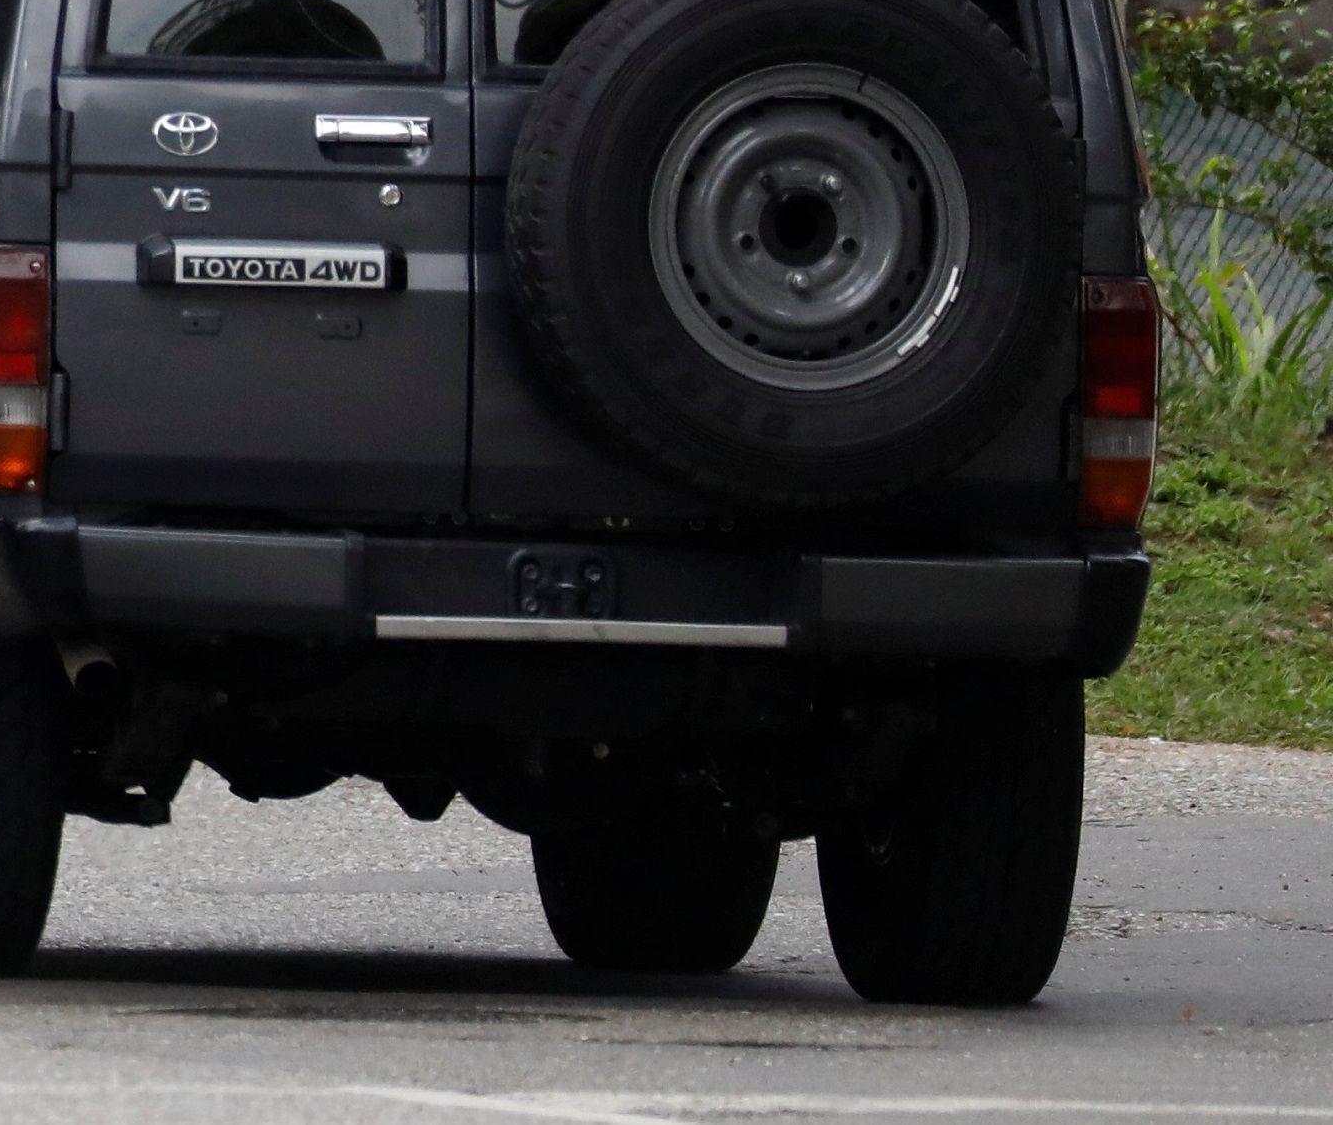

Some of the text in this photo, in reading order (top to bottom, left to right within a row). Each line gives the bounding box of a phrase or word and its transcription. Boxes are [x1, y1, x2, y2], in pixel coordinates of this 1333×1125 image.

[153, 187, 211, 213] V6
[189, 259, 383, 282] TOYOTA 4WD
